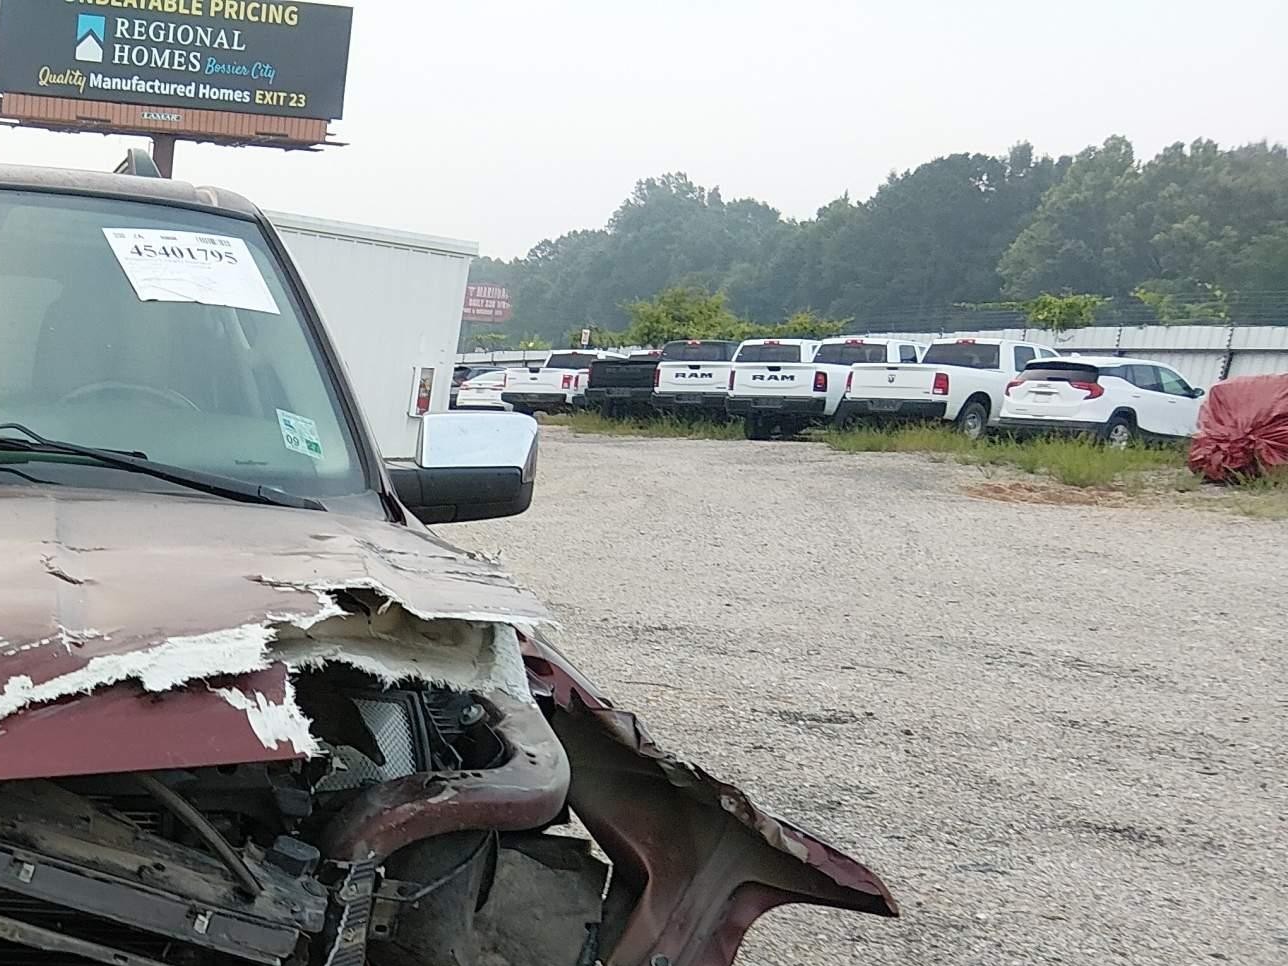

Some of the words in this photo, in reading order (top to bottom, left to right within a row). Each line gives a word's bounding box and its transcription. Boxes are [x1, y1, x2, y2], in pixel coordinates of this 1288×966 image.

[64, 0, 203, 16] TABLE
[209, 0, 298, 26] PRICING
[113, 17, 247, 51] REGIONAL
[112, 43, 201, 72] HOMES
[204, 57, 250, 76] Bossier
[251, 62, 276, 84] City
[38, 66, 87, 94] Quality
[89, 72, 195, 98] Manufactured
[198, 84, 251, 103] Homes
[254, 90, 287, 106] EXIT
[288, 93, 306, 107] 23
[130, 244, 239, 265] 45401795
